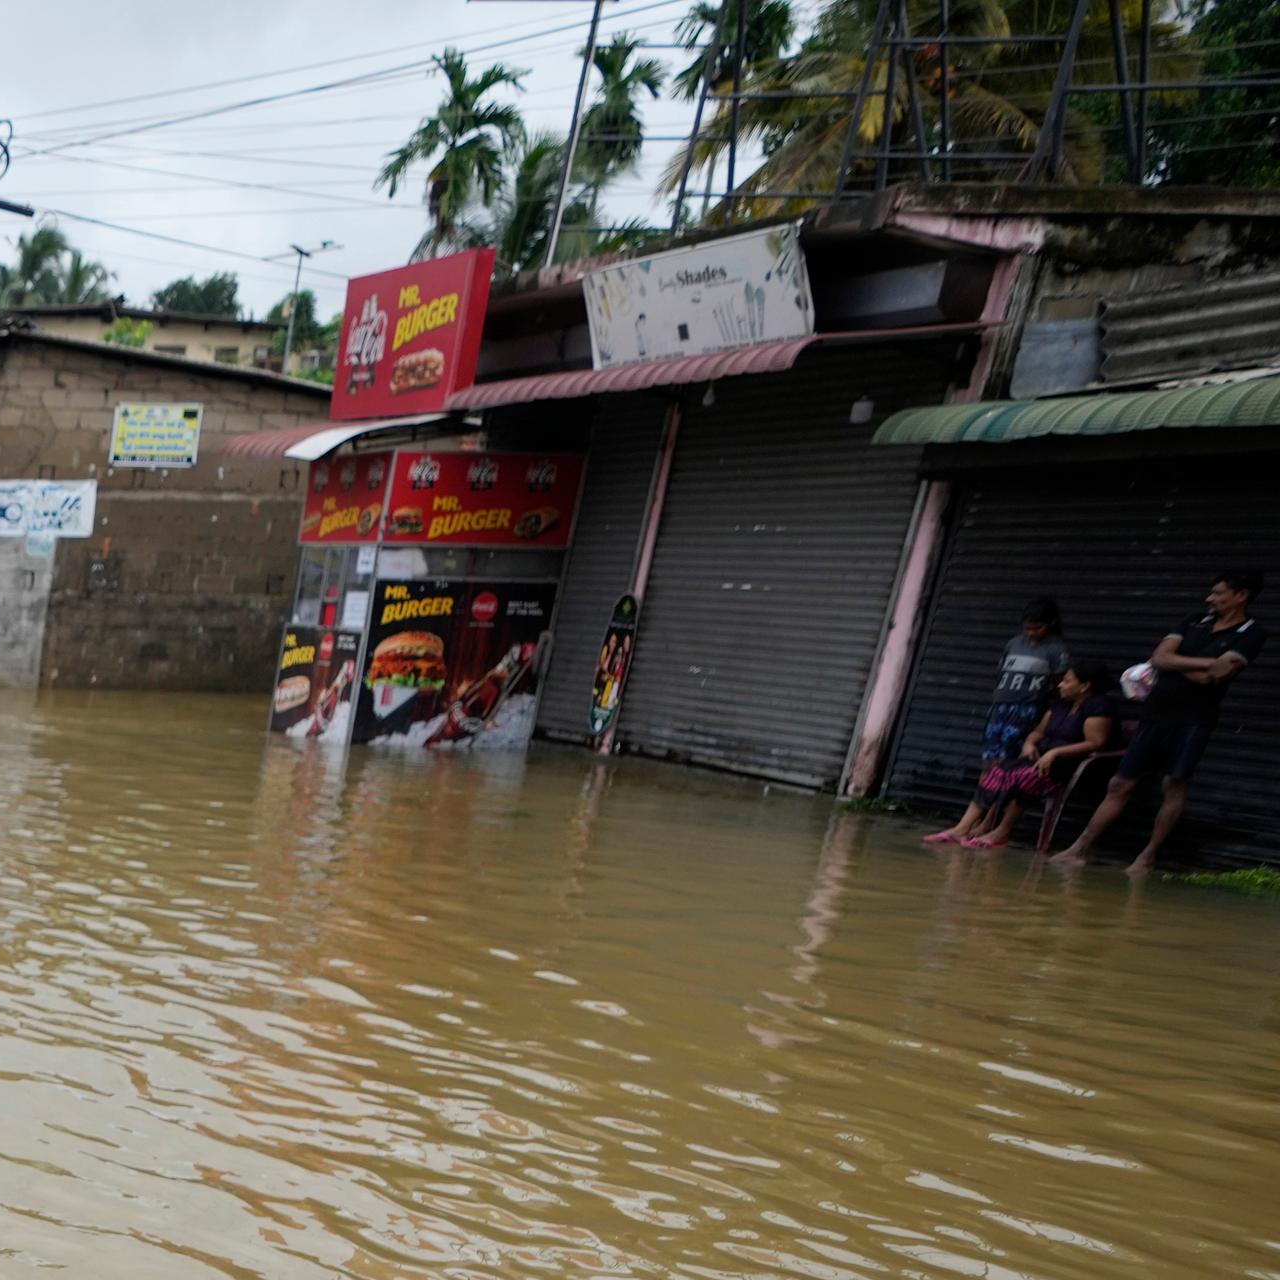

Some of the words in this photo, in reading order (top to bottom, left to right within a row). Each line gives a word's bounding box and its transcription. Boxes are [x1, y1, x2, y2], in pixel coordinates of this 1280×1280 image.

[677, 265, 727, 287] Shades
[399, 284, 421, 309] MR.
[392, 292, 459, 352] BURGER
[433, 496, 461, 511] MR.
[318, 506, 361, 538] BURGER
[427, 508, 512, 540] BURGER
[384, 585, 410, 599] MR.
[380, 597, 454, 625] BURGER
[281, 645, 316, 670] BURGER
